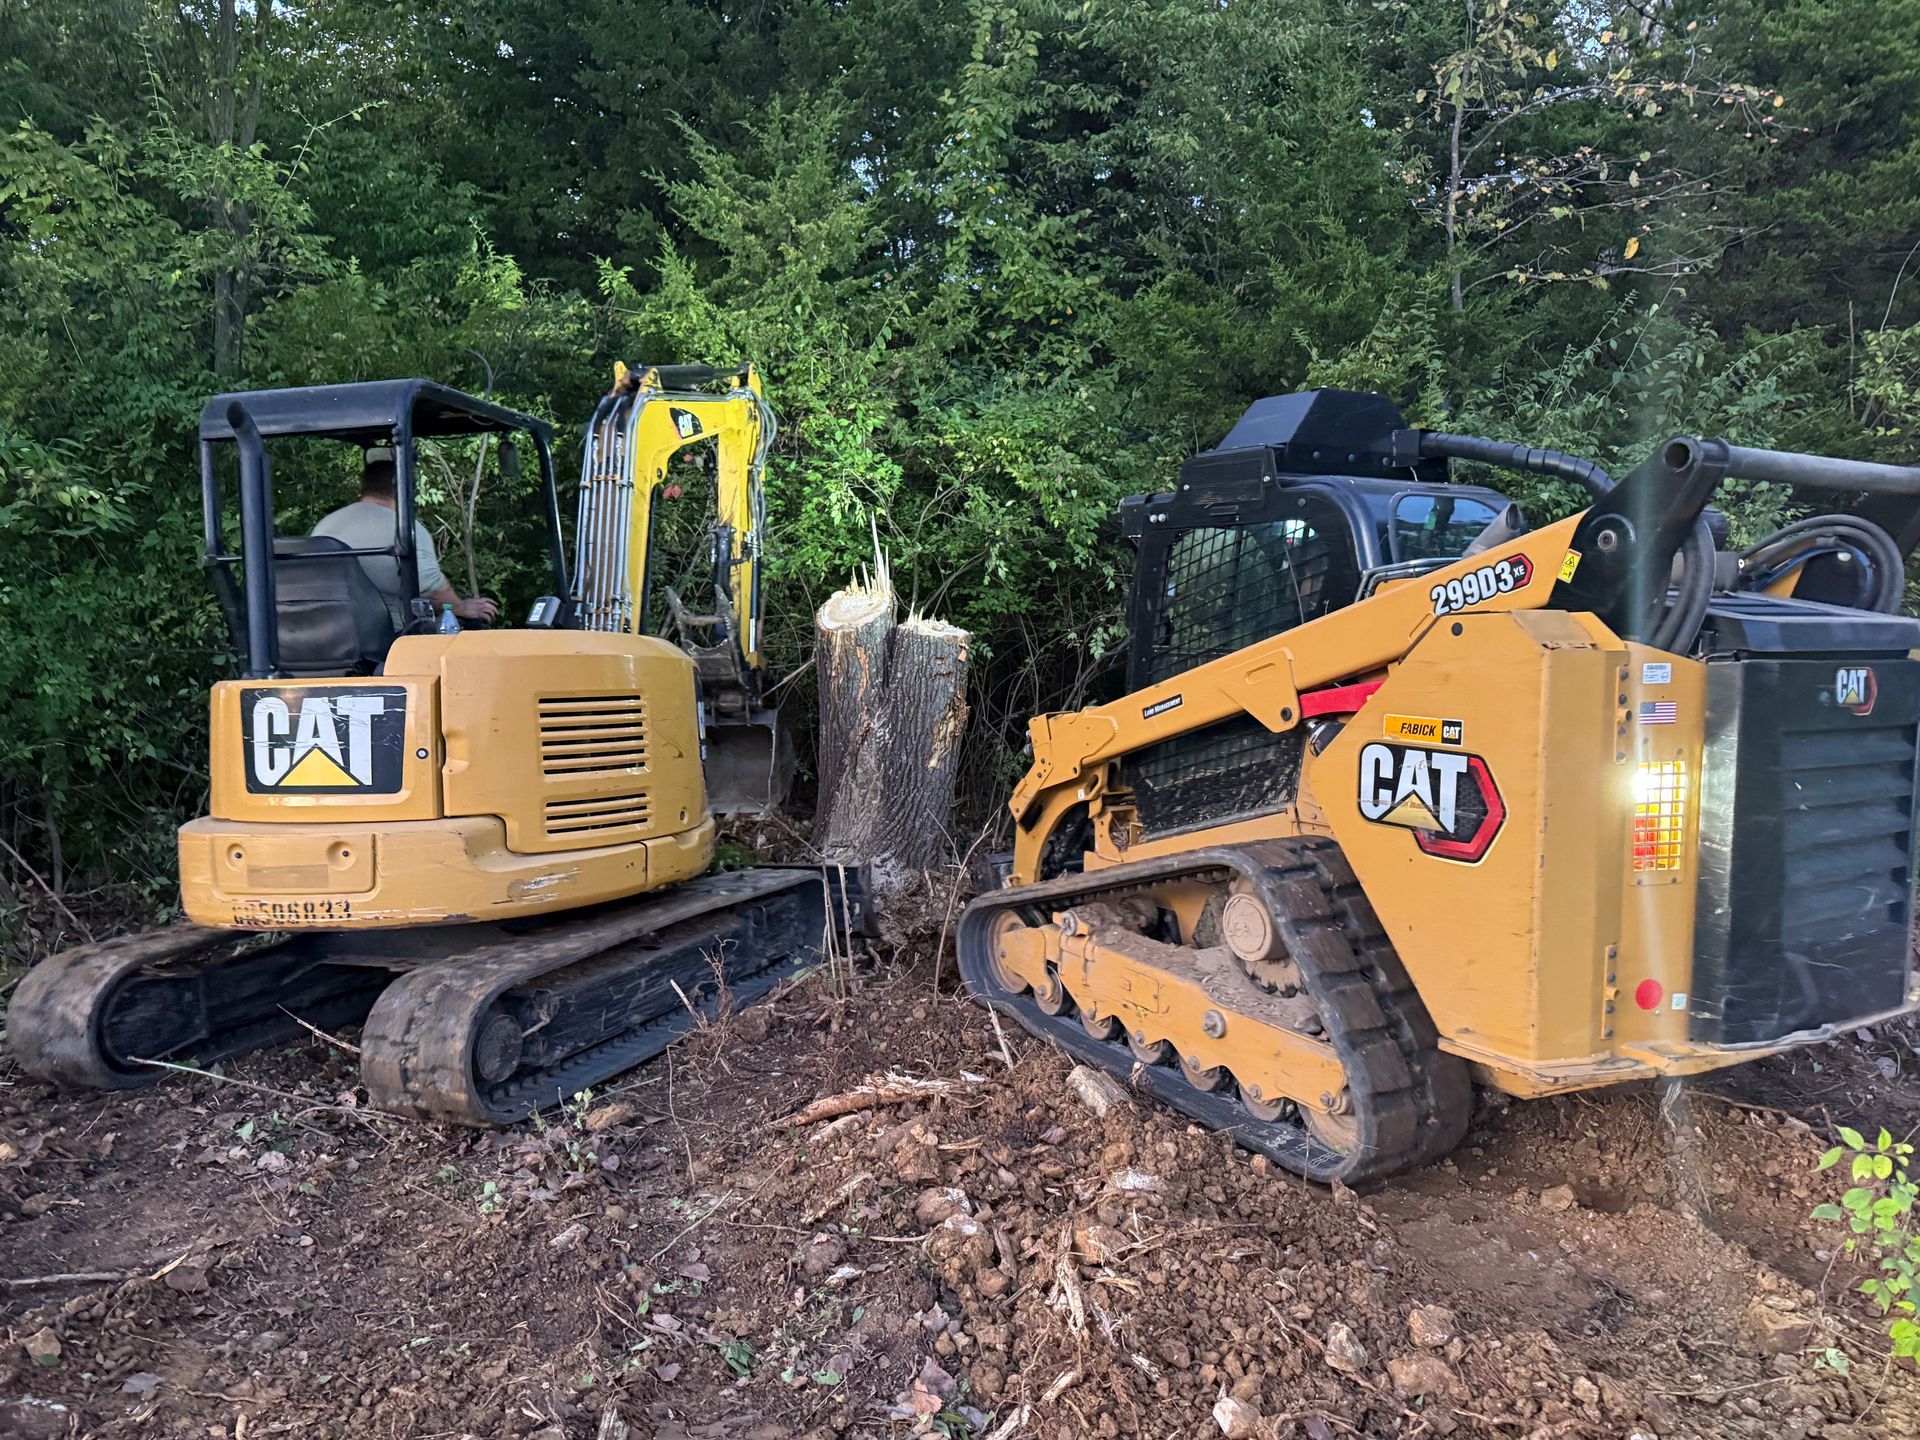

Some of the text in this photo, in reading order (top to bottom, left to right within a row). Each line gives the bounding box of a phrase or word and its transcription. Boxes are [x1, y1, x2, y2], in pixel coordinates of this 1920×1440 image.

[678, 413, 694, 438] CAT
[1431, 560, 1526, 616] 299D3 XE
[1836, 669, 1868, 704] CAT
[253, 696, 385, 787] CAT
[1400, 722, 1461, 740] FABICK CAT
[1360, 743, 1468, 834] CAT
